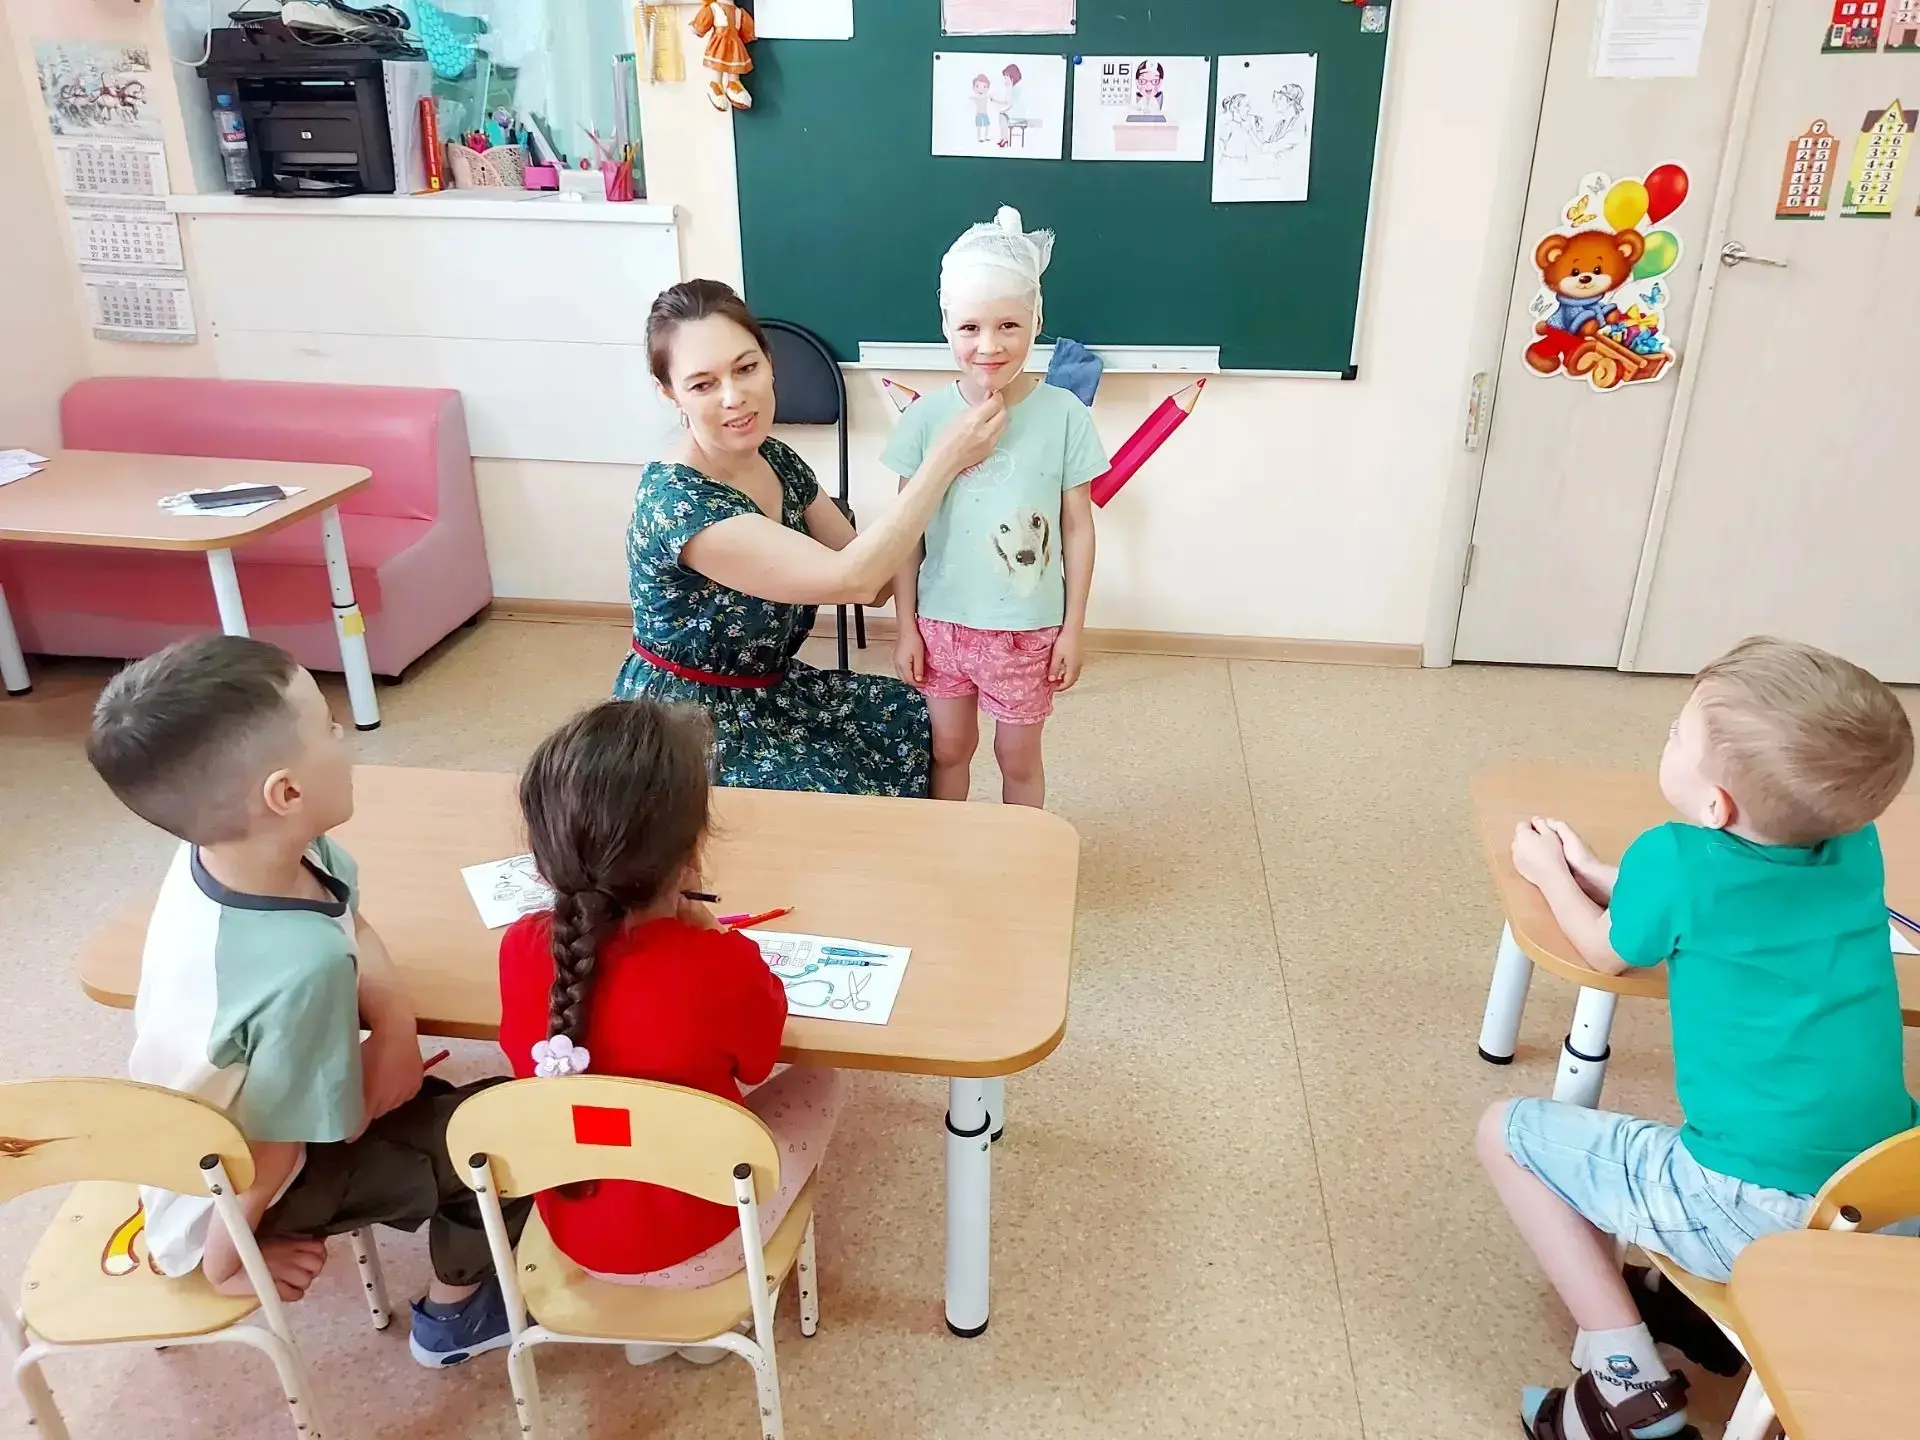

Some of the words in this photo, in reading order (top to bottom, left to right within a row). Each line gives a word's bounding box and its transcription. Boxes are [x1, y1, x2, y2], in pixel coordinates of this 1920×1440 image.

[1846, 5, 1852, 13] 1
[1866, 4, 1872, 13] 1
[1103, 64, 1115, 75] Ш
[1118, 64, 1130, 75] Б
[1816, 124, 1823, 132] 7
